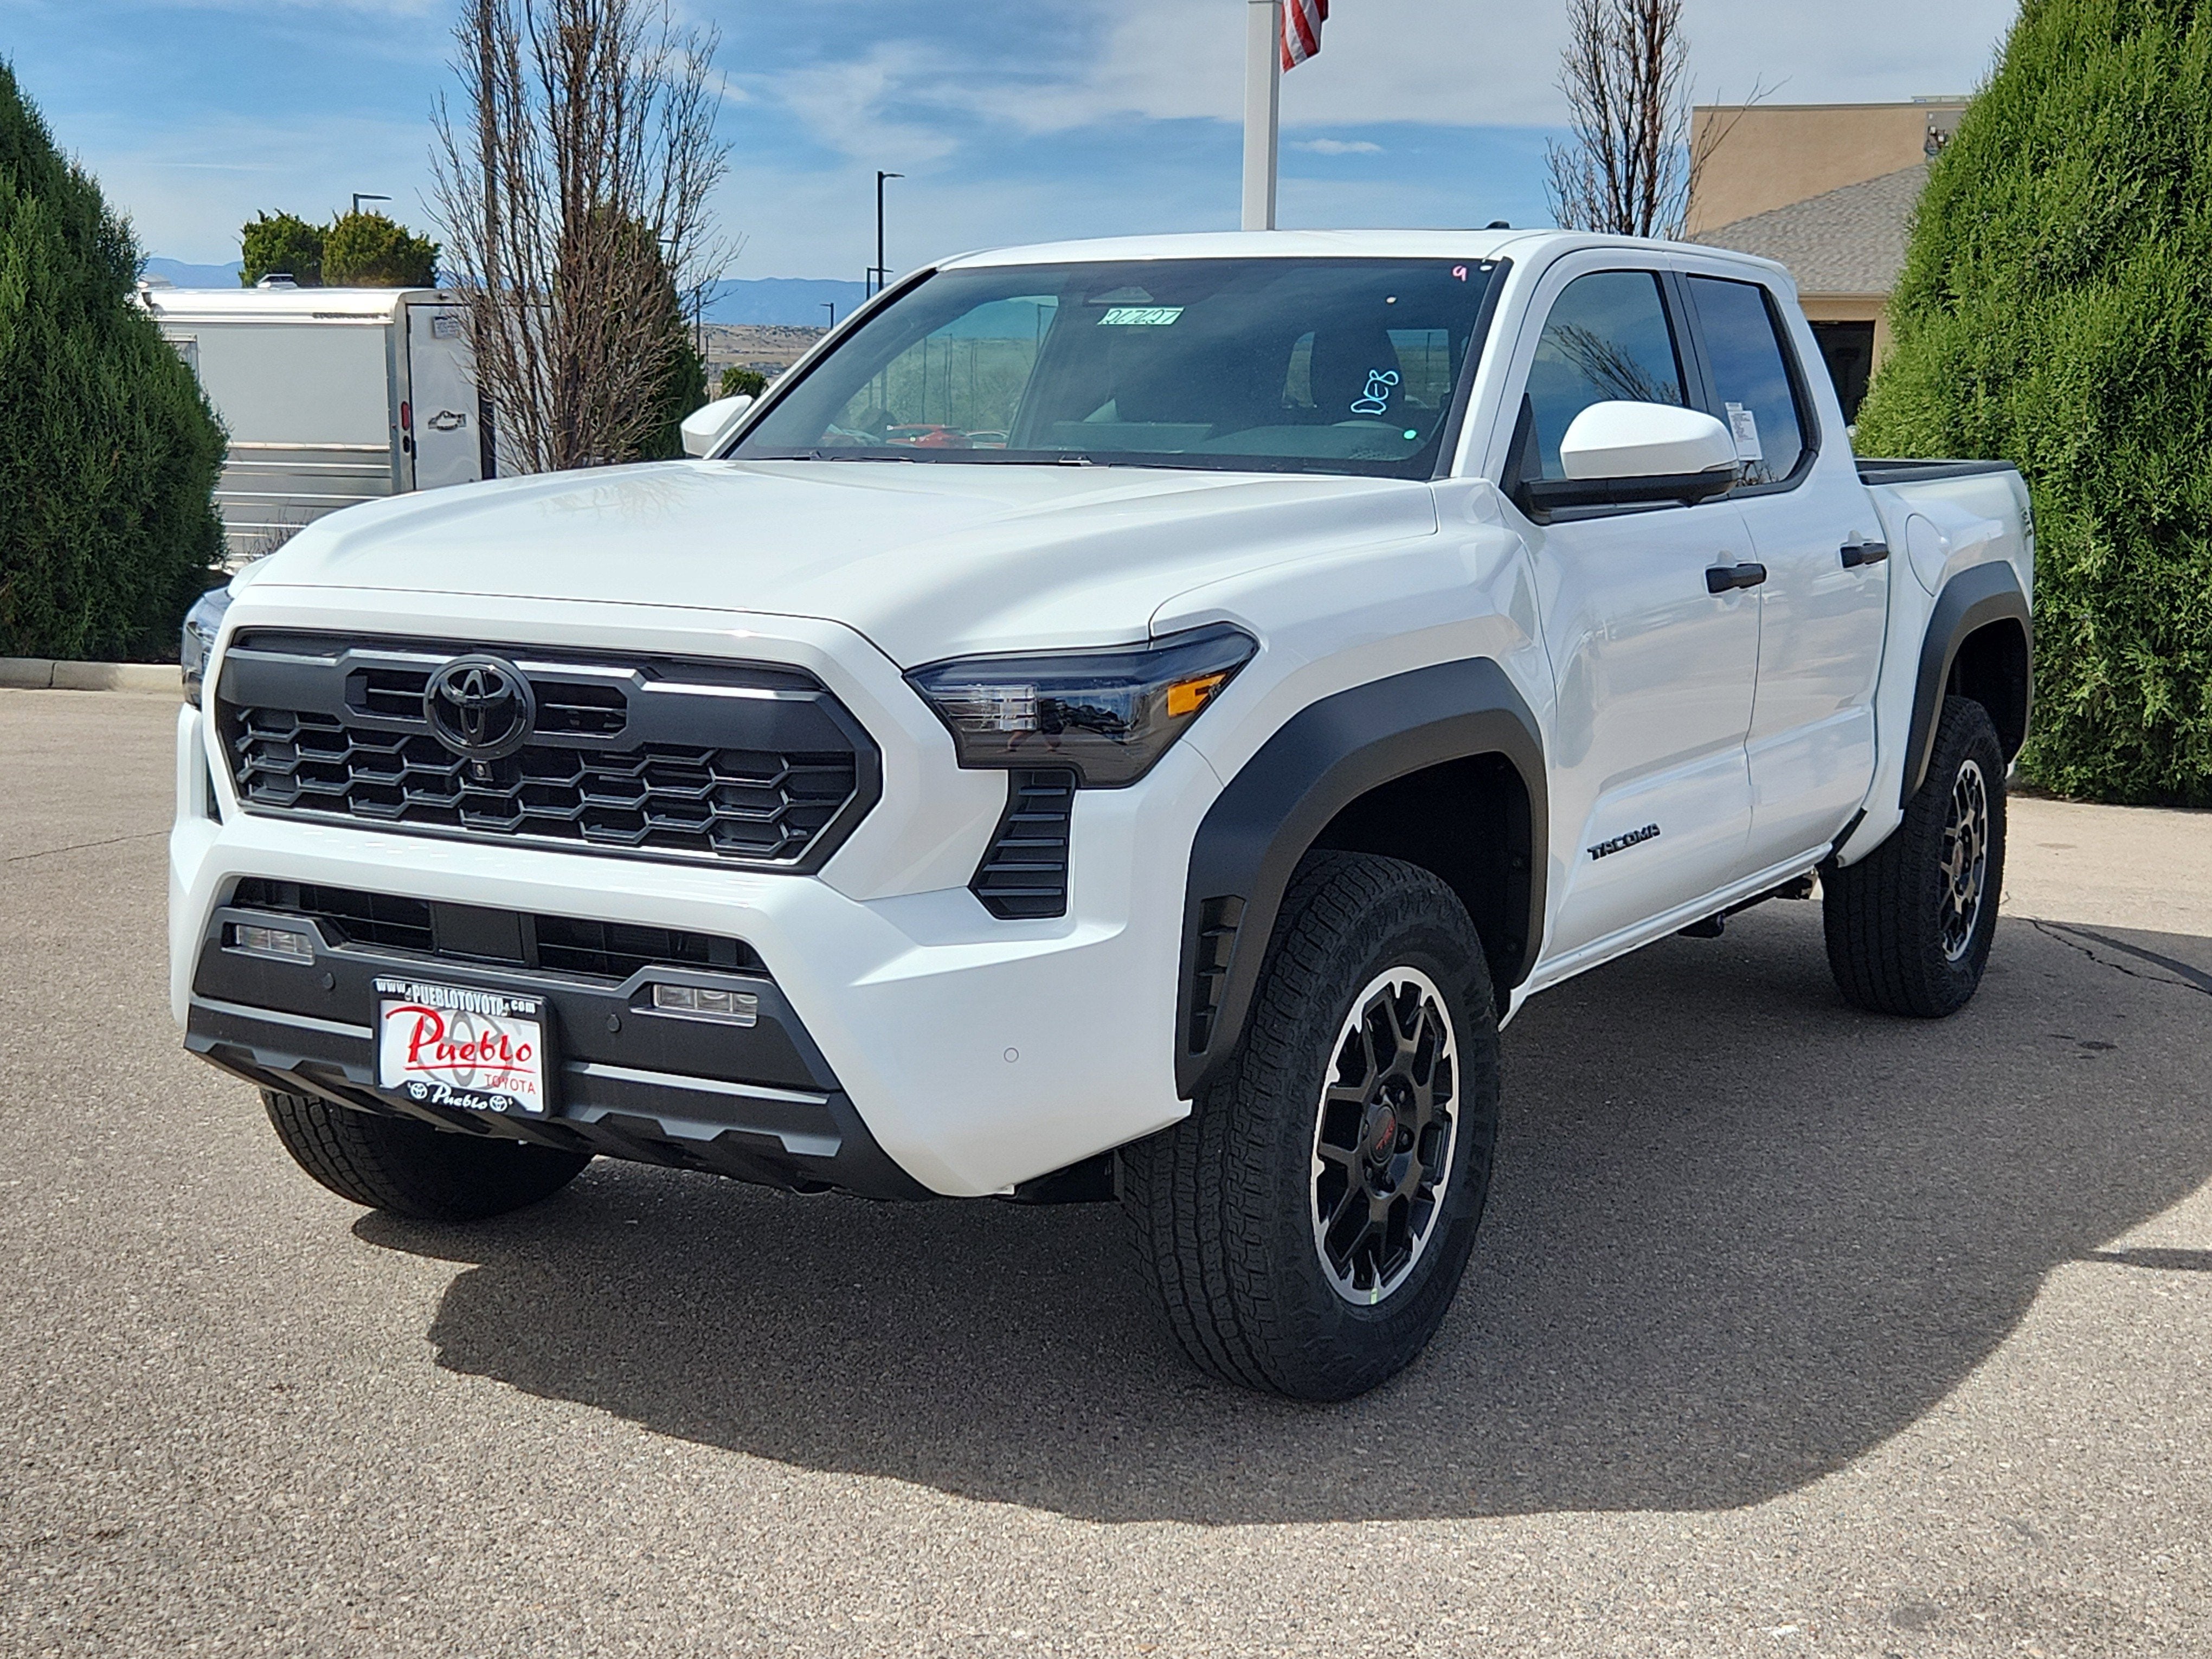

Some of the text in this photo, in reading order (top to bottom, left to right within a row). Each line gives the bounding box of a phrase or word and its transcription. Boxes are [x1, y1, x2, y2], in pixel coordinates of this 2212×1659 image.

[1587, 823, 1661, 861] TACOMA
[385, 1006, 533, 1063] Pueblo
[426, 1081, 488, 1110] Pueblo
[484, 1073, 536, 1095] TOYOTA
